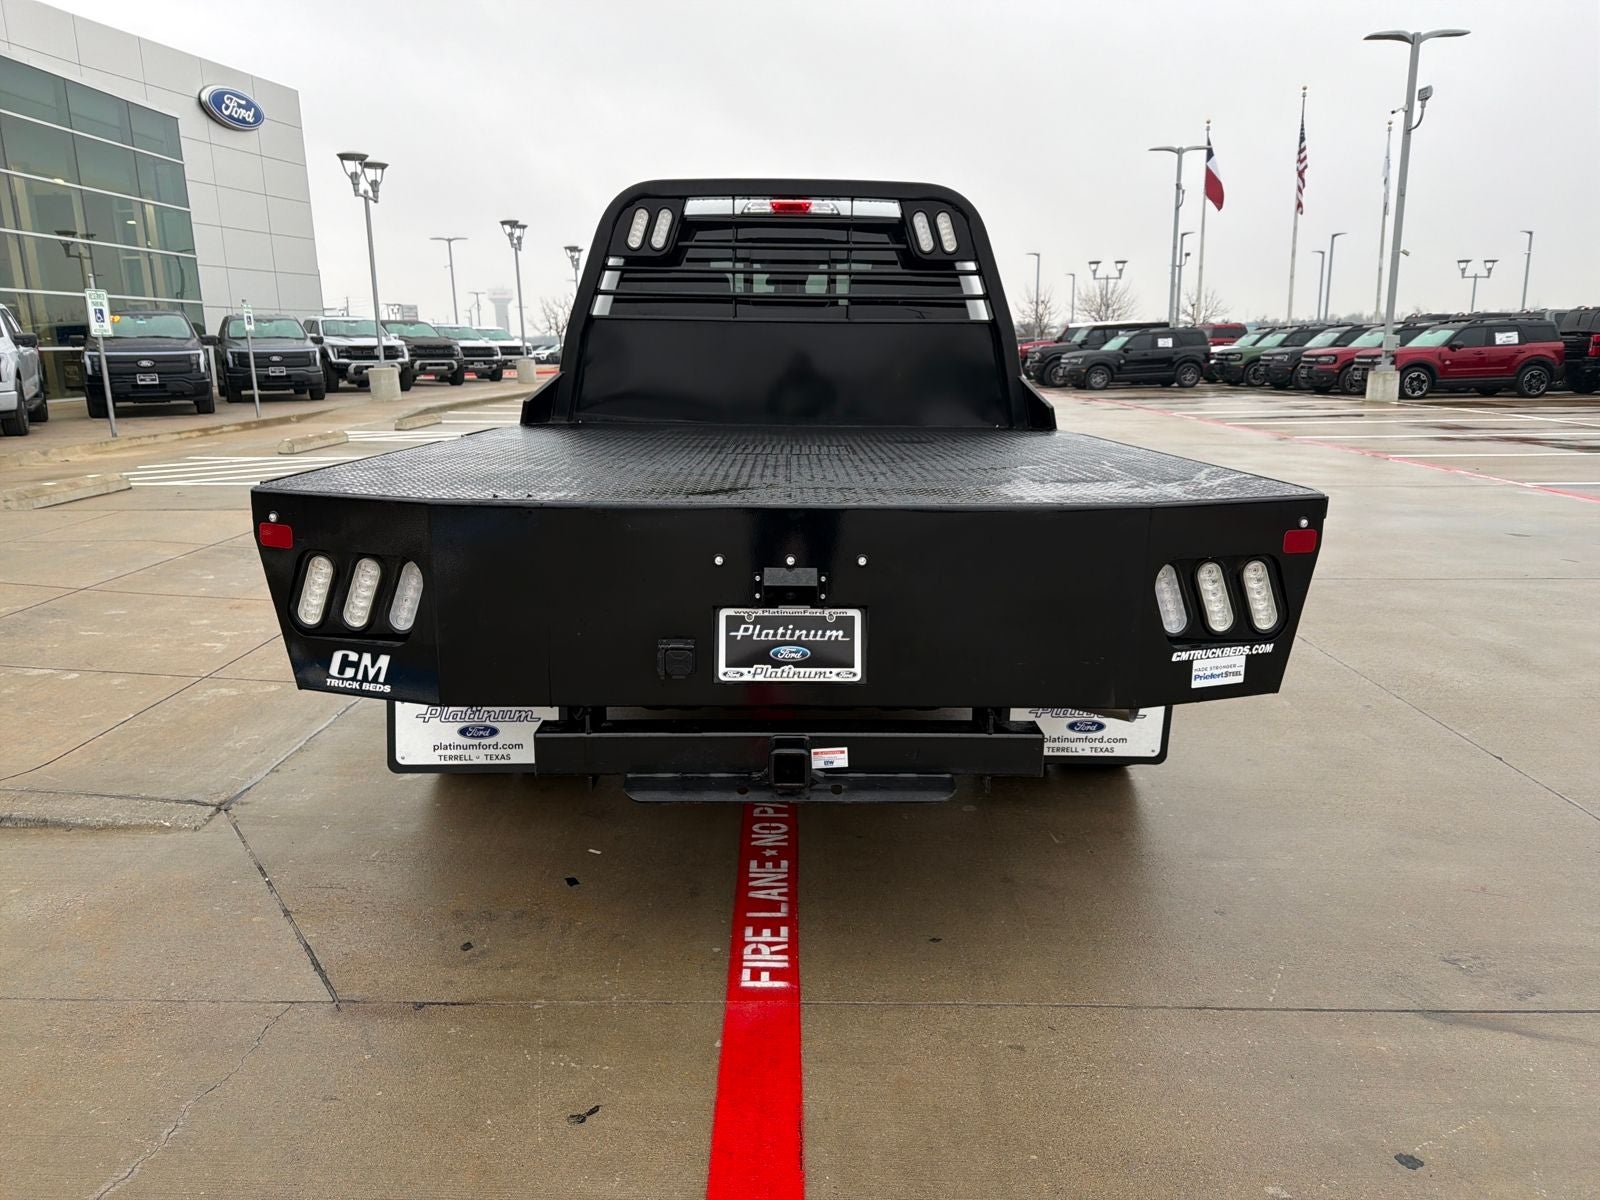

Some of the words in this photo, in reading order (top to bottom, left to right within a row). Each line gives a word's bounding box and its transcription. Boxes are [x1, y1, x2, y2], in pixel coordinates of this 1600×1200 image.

[222, 94, 255, 123] Ford
[729, 624, 850, 641] Platinum
[777, 648, 803, 659] Ford
[1171, 643, 1275, 662] CMTRUCKBEDS.COM
[328, 649, 391, 683] CM
[752, 666, 832, 679] Platinum
[326, 678, 361, 690] TRUCK
[362, 682, 392, 693] BEDS
[416, 705, 541, 723] Platinum
[466, 726, 491, 737] Ford
[1074, 721, 1098, 731] Ford
[433, 741, 524, 752] platinumford.com
[438, 754, 474, 762] TERRELL
[484, 753, 511, 761] TEXAS
[751, 822, 789, 846] NO
[746, 859, 789, 917] LANE
[740, 926, 790, 988] FIRE
